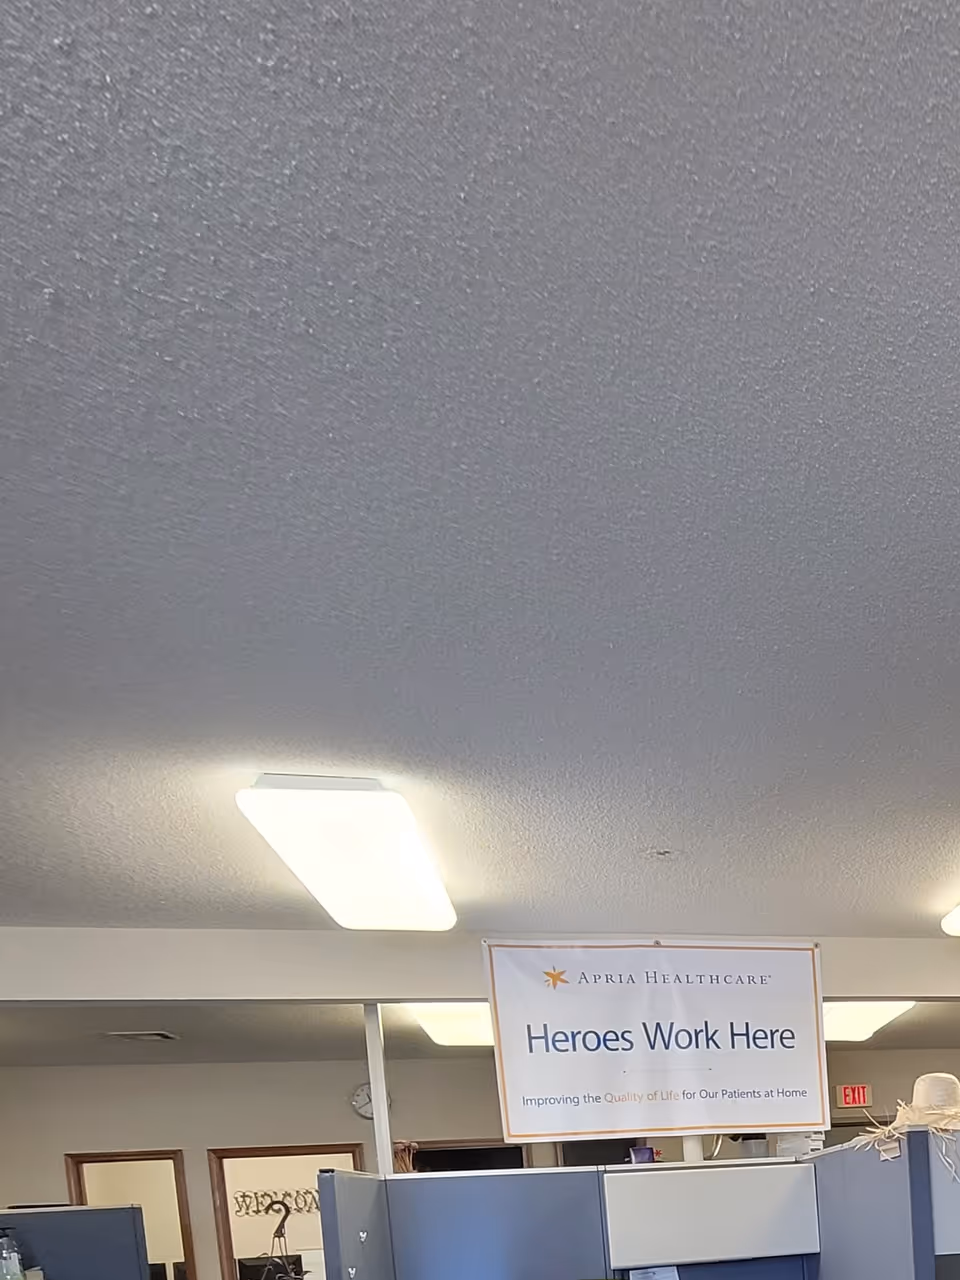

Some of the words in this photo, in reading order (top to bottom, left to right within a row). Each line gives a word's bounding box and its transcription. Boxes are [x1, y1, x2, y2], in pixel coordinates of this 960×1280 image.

[578, 971, 636, 984] APRIA
[526, 1022, 634, 1054] Heroes
[641, 1020, 722, 1050] Work
[729, 1020, 796, 1050] Here
[522, 1095, 580, 1108] Improving
[583, 1092, 601, 1104] the
[604, 1092, 644, 1104] Quality
[647, 1090, 659, 1101] of
[660, 1090, 680, 1101] Life
[682, 1089, 697, 1100] for
[699, 1089, 719, 1099] Our
[721, 1088, 762, 1099] Patients
[764, 1088, 775, 1098] at
[777, 1088, 808, 1098] Home
[843, 1086, 867, 1105] EXIT
